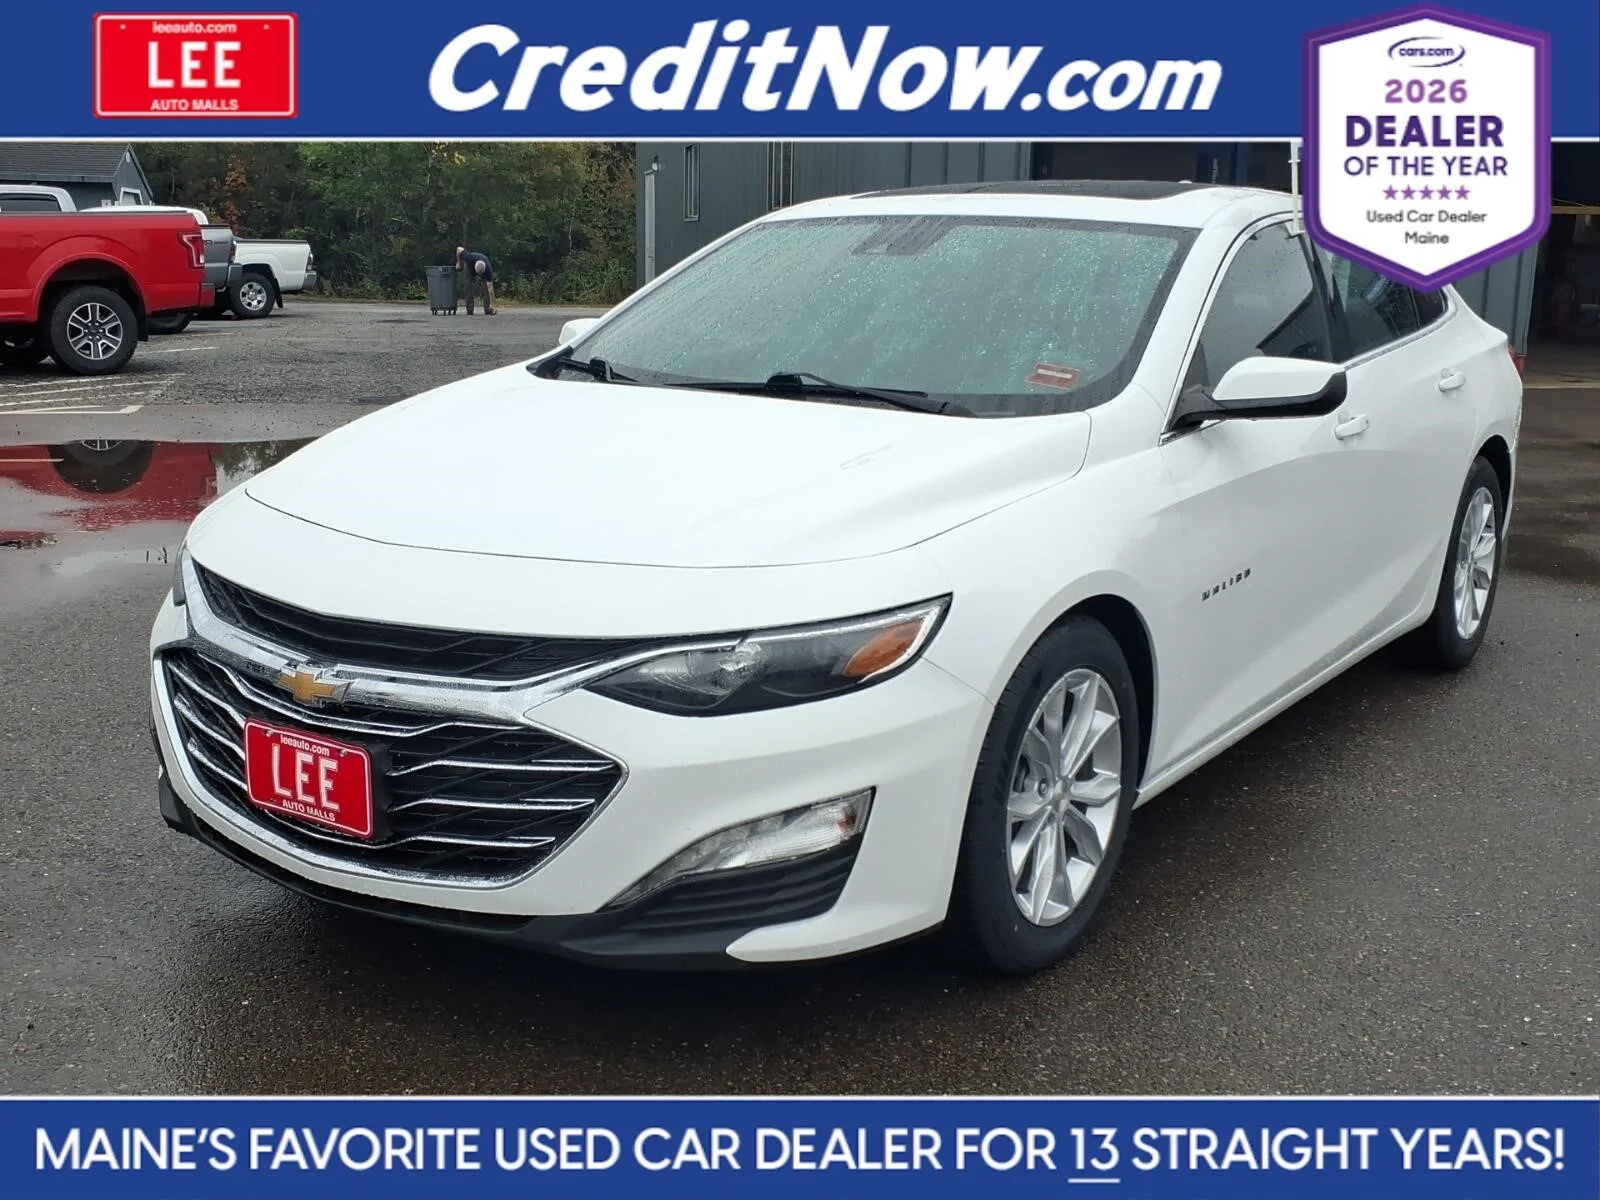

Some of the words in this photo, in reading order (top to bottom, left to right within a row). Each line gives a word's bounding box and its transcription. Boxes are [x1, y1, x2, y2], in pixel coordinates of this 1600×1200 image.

[280, 735, 330, 757] leeauto.com
[272, 743, 340, 811] LEE
[282, 800, 306, 813] AUTO
[307, 806, 336, 822] MALLS
